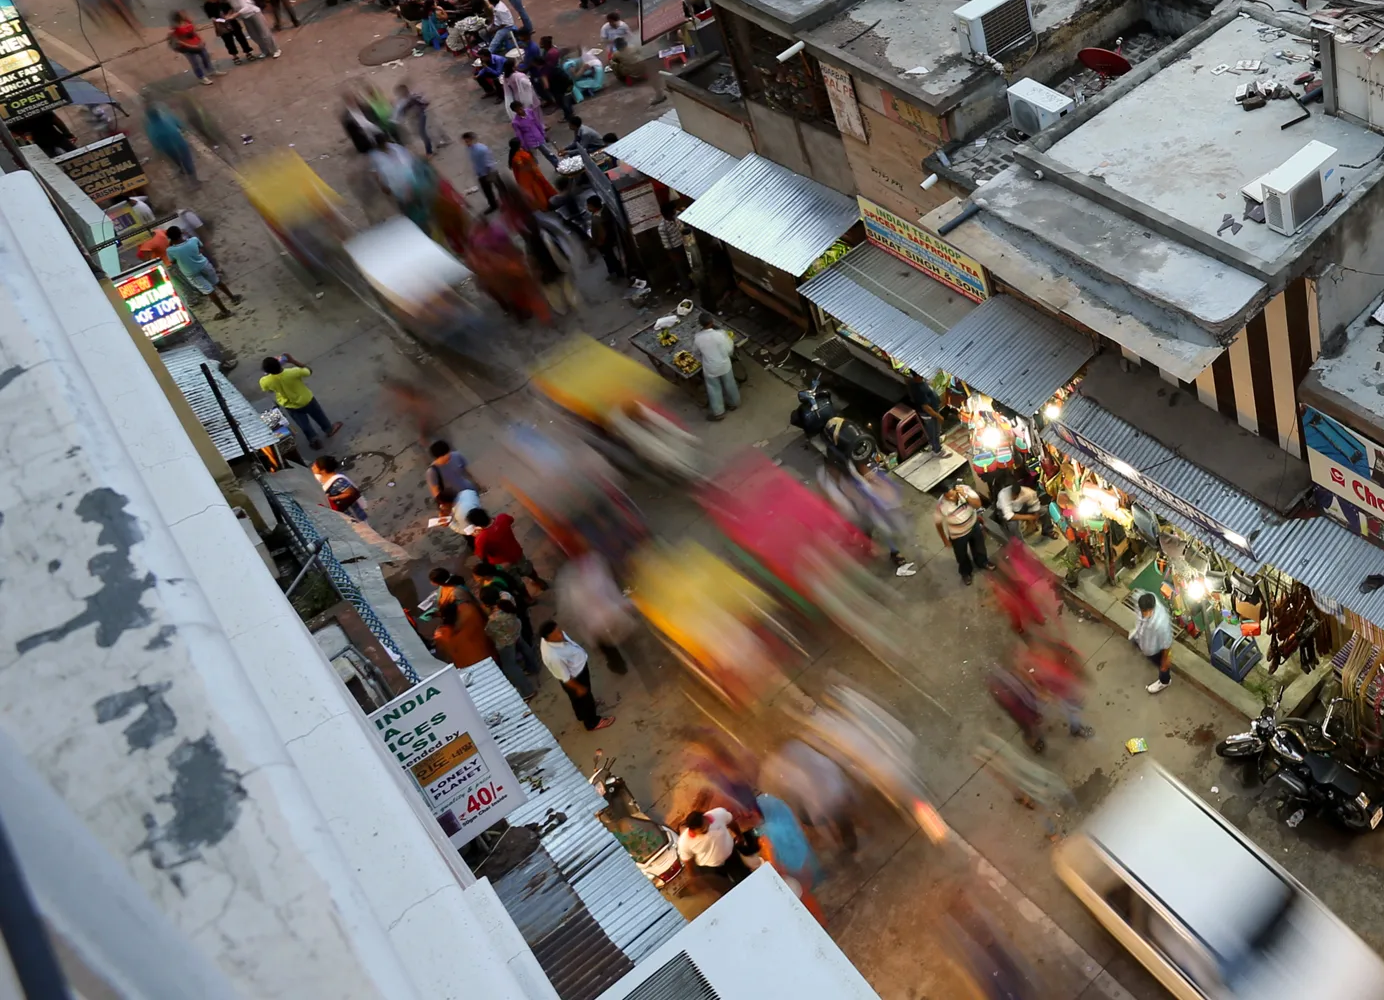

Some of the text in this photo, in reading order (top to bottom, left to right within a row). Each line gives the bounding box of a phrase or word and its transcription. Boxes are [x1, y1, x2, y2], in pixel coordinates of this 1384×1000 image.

[17, 63, 44, 77] FAST
[32, 75, 41, 84] &
[10, 91, 46, 109] OPEN
[17, 100, 49, 115] ENTRANCE
[3, 114, 25, 126] HOTEL
[25, 109, 41, 118] LORD
[69, 157, 113, 178] CAFE
[84, 176, 122, 193] CALL
[863, 209, 980, 278] SPICES SAFFRON TEA
[876, 208, 962, 259] INDIAN TEA SHOP
[866, 228, 987, 300] SURAT SINGH & SONS
[117, 275, 152, 299] NEW
[374, 686, 441, 730] INDIA
[445, 730, 460, 742] by
[430, 758, 480, 794] LONELY
[433, 765, 482, 801] PLANET
[466, 781, 504, 815] 40/-
[491, 794, 508, 811] Inside
